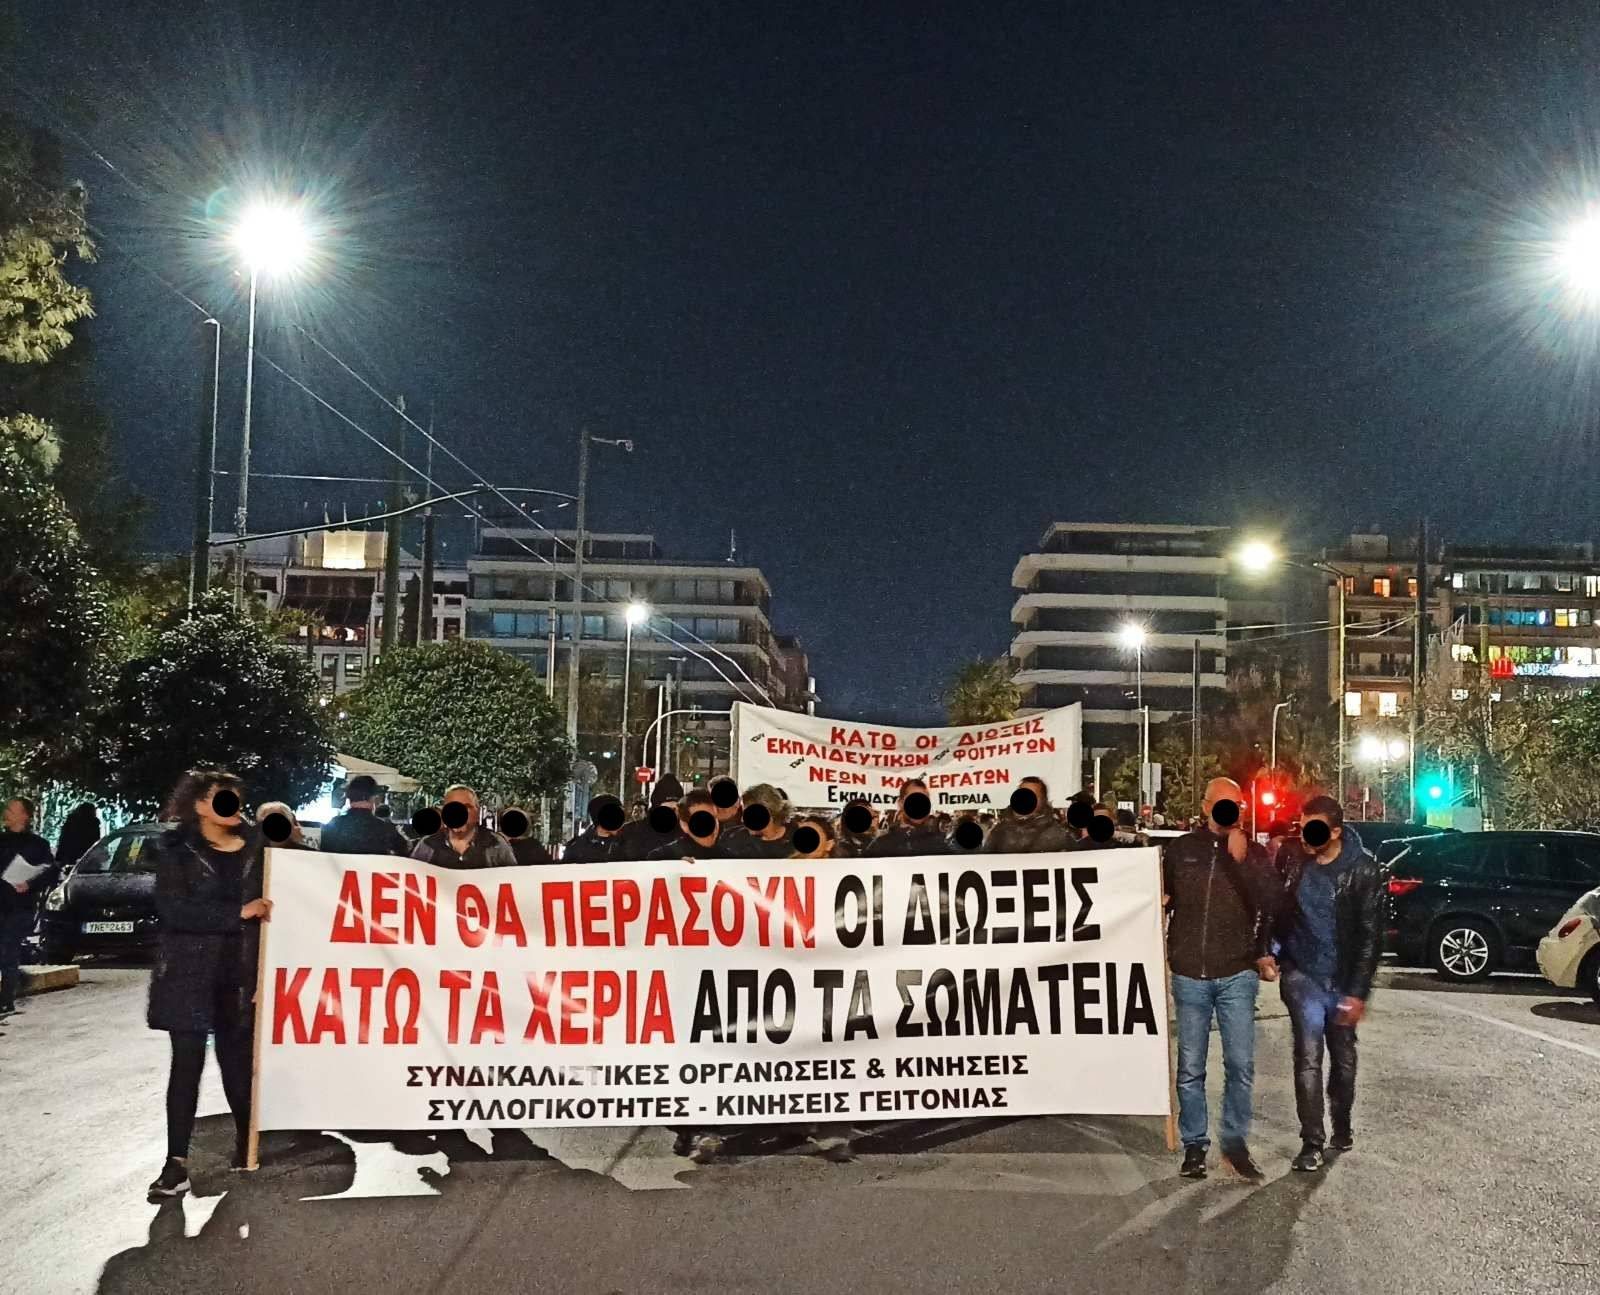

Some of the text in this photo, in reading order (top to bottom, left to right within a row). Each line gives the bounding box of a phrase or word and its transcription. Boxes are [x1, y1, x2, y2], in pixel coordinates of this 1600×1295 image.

[831, 717, 1045, 750] ΚΑΤΩ ΟΙ ΔΙΩΞΕΙΣ
[767, 737, 929, 768] ΕΚΠΑΙΔΕΥΤΙΚΩΝ
[953, 737, 1056, 761] ΦΟΙΤΗΤΩΝ
[809, 766, 866, 785] ΝΕΩΝ
[881, 775, 910, 789] ΚΑ
[929, 769, 1010, 789] ΕΡΓΑΤΩΝ
[939, 792, 991, 805] ΠΕΙΡΑΙΑ
[330, 866, 1101, 949] ΔΕΝ ΘΑ ΠΕΡΑΣΟΥΝ ΟΙ ΔΙΩΞΕΙΣ
[272, 961, 1159, 1045] ΚΑΤΩ ΤΑ ΧΕΡΙΑ ΑΠΟ ΤΑ ΣΩΜΑΤΕΙΑ
[406, 1055, 1029, 1087] ΣΥΝΔΙΚΑΛΙΣΤΙΚΕΣ ΟΡΓΑΝΩΣΕΙΣ & ΚΙΝΗΣΕΙΣ
[427, 1096, 690, 1121] ΣΥΛΛΟΓΙΚΟΤΗΤΕΣ
[717, 1092, 850, 1116] ΚΙΝΗΣΕΙΣ
[860, 1087, 1008, 1112] ΓΕΙΤΟΝΙΑΣ
